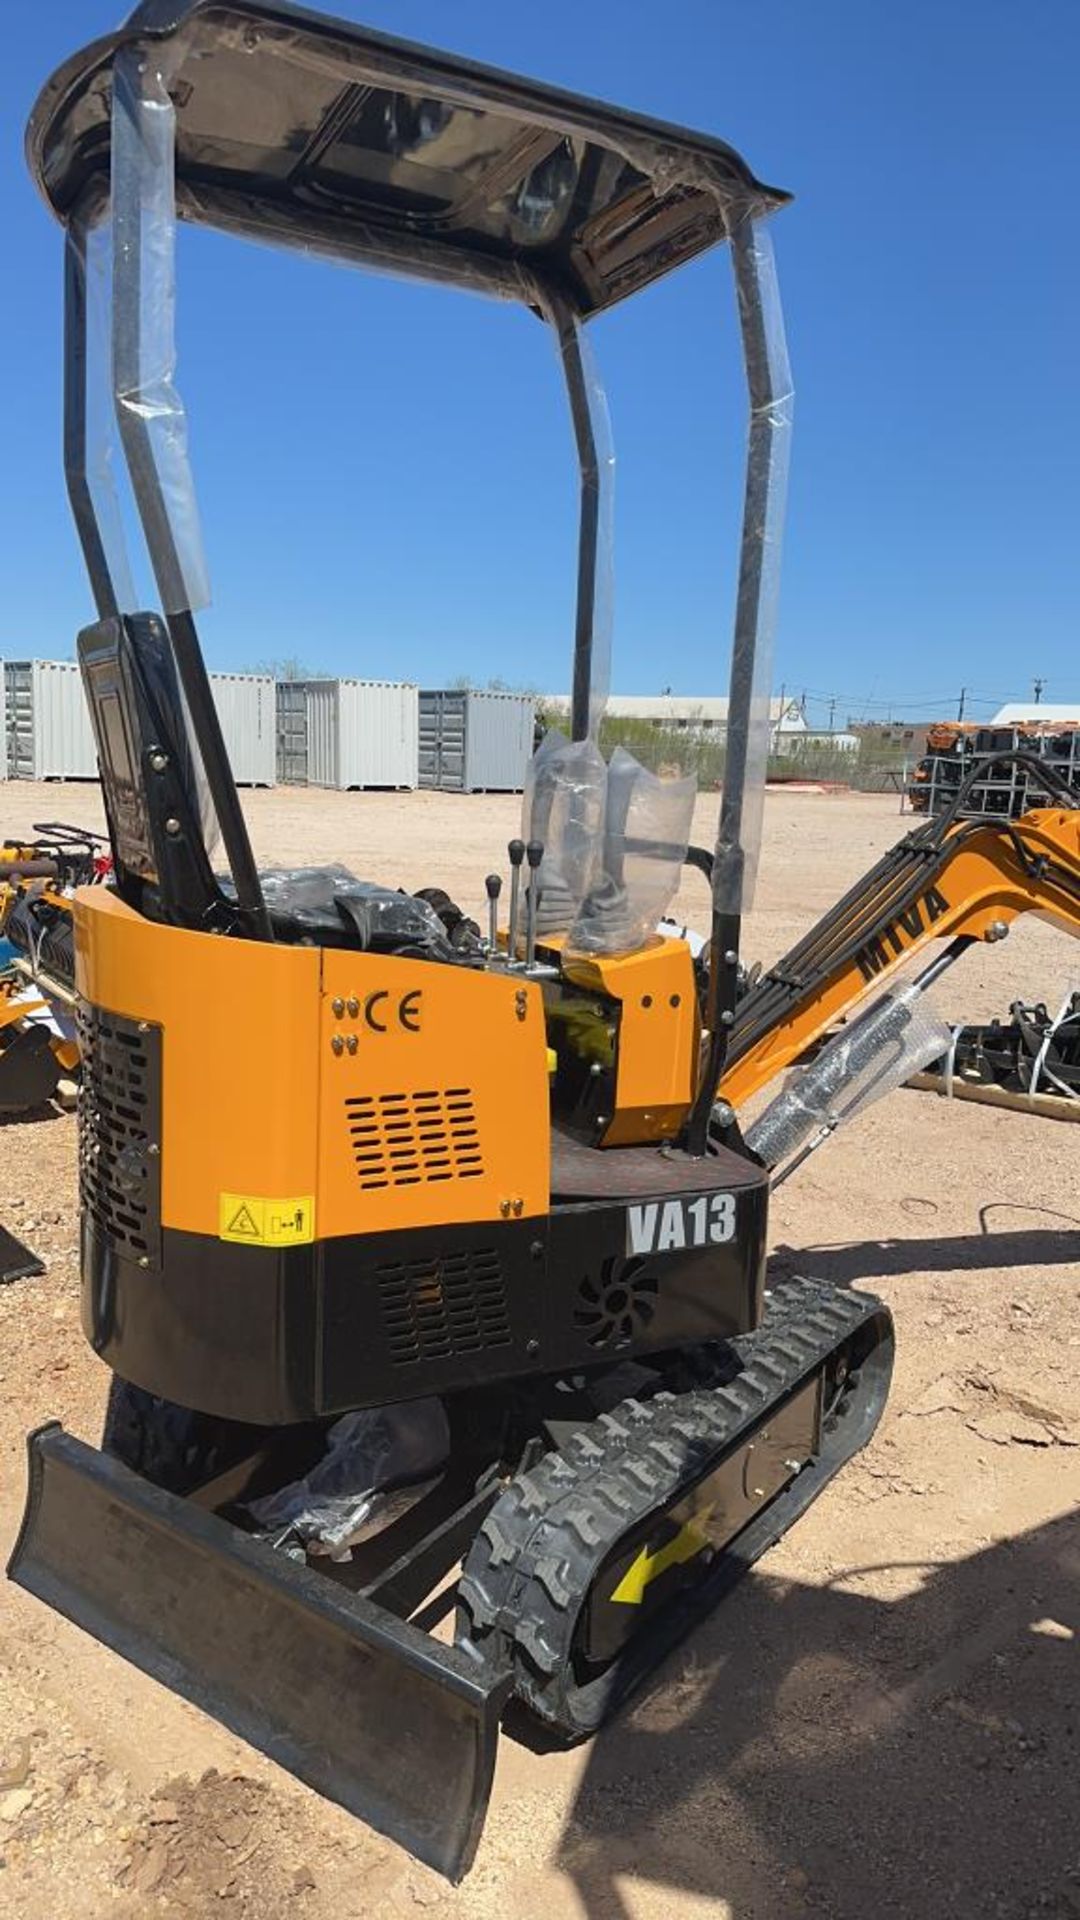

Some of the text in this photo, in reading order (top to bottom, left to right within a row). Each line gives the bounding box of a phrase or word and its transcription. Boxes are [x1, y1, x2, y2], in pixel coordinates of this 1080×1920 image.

[854, 887, 950, 982] MIVA
[365, 989, 422, 1032] CE
[628, 1193, 736, 1254] VA13
